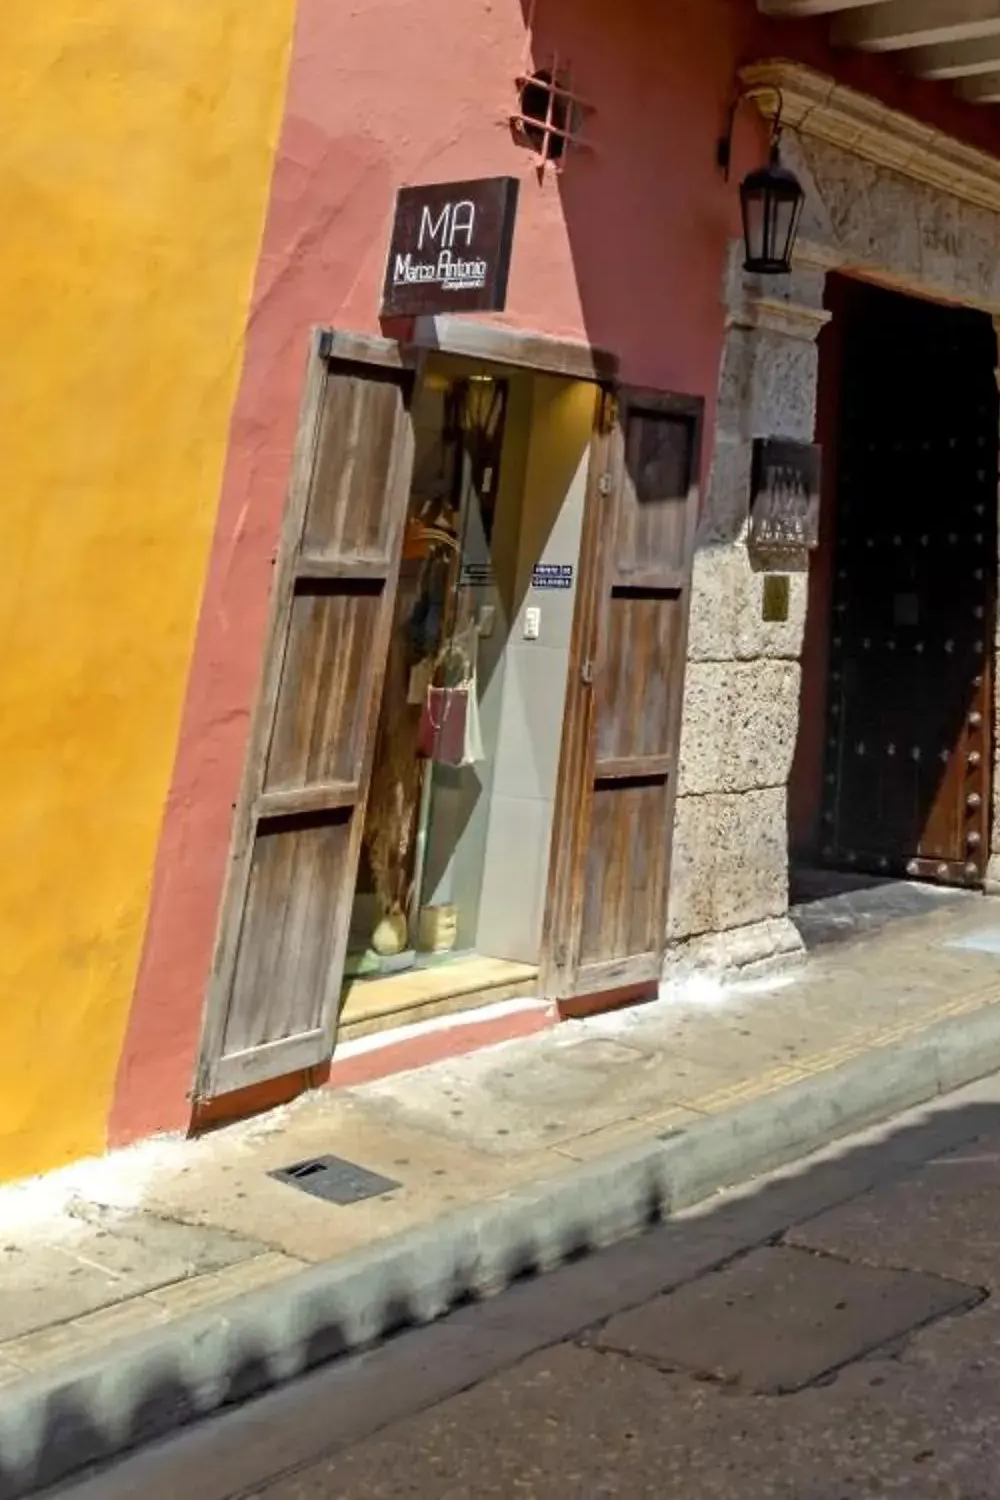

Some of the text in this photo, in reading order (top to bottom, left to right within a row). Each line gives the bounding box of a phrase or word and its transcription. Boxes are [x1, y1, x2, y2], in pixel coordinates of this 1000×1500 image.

[417, 201, 476, 250] MA
[393, 250, 487, 282] Marco Antonio
